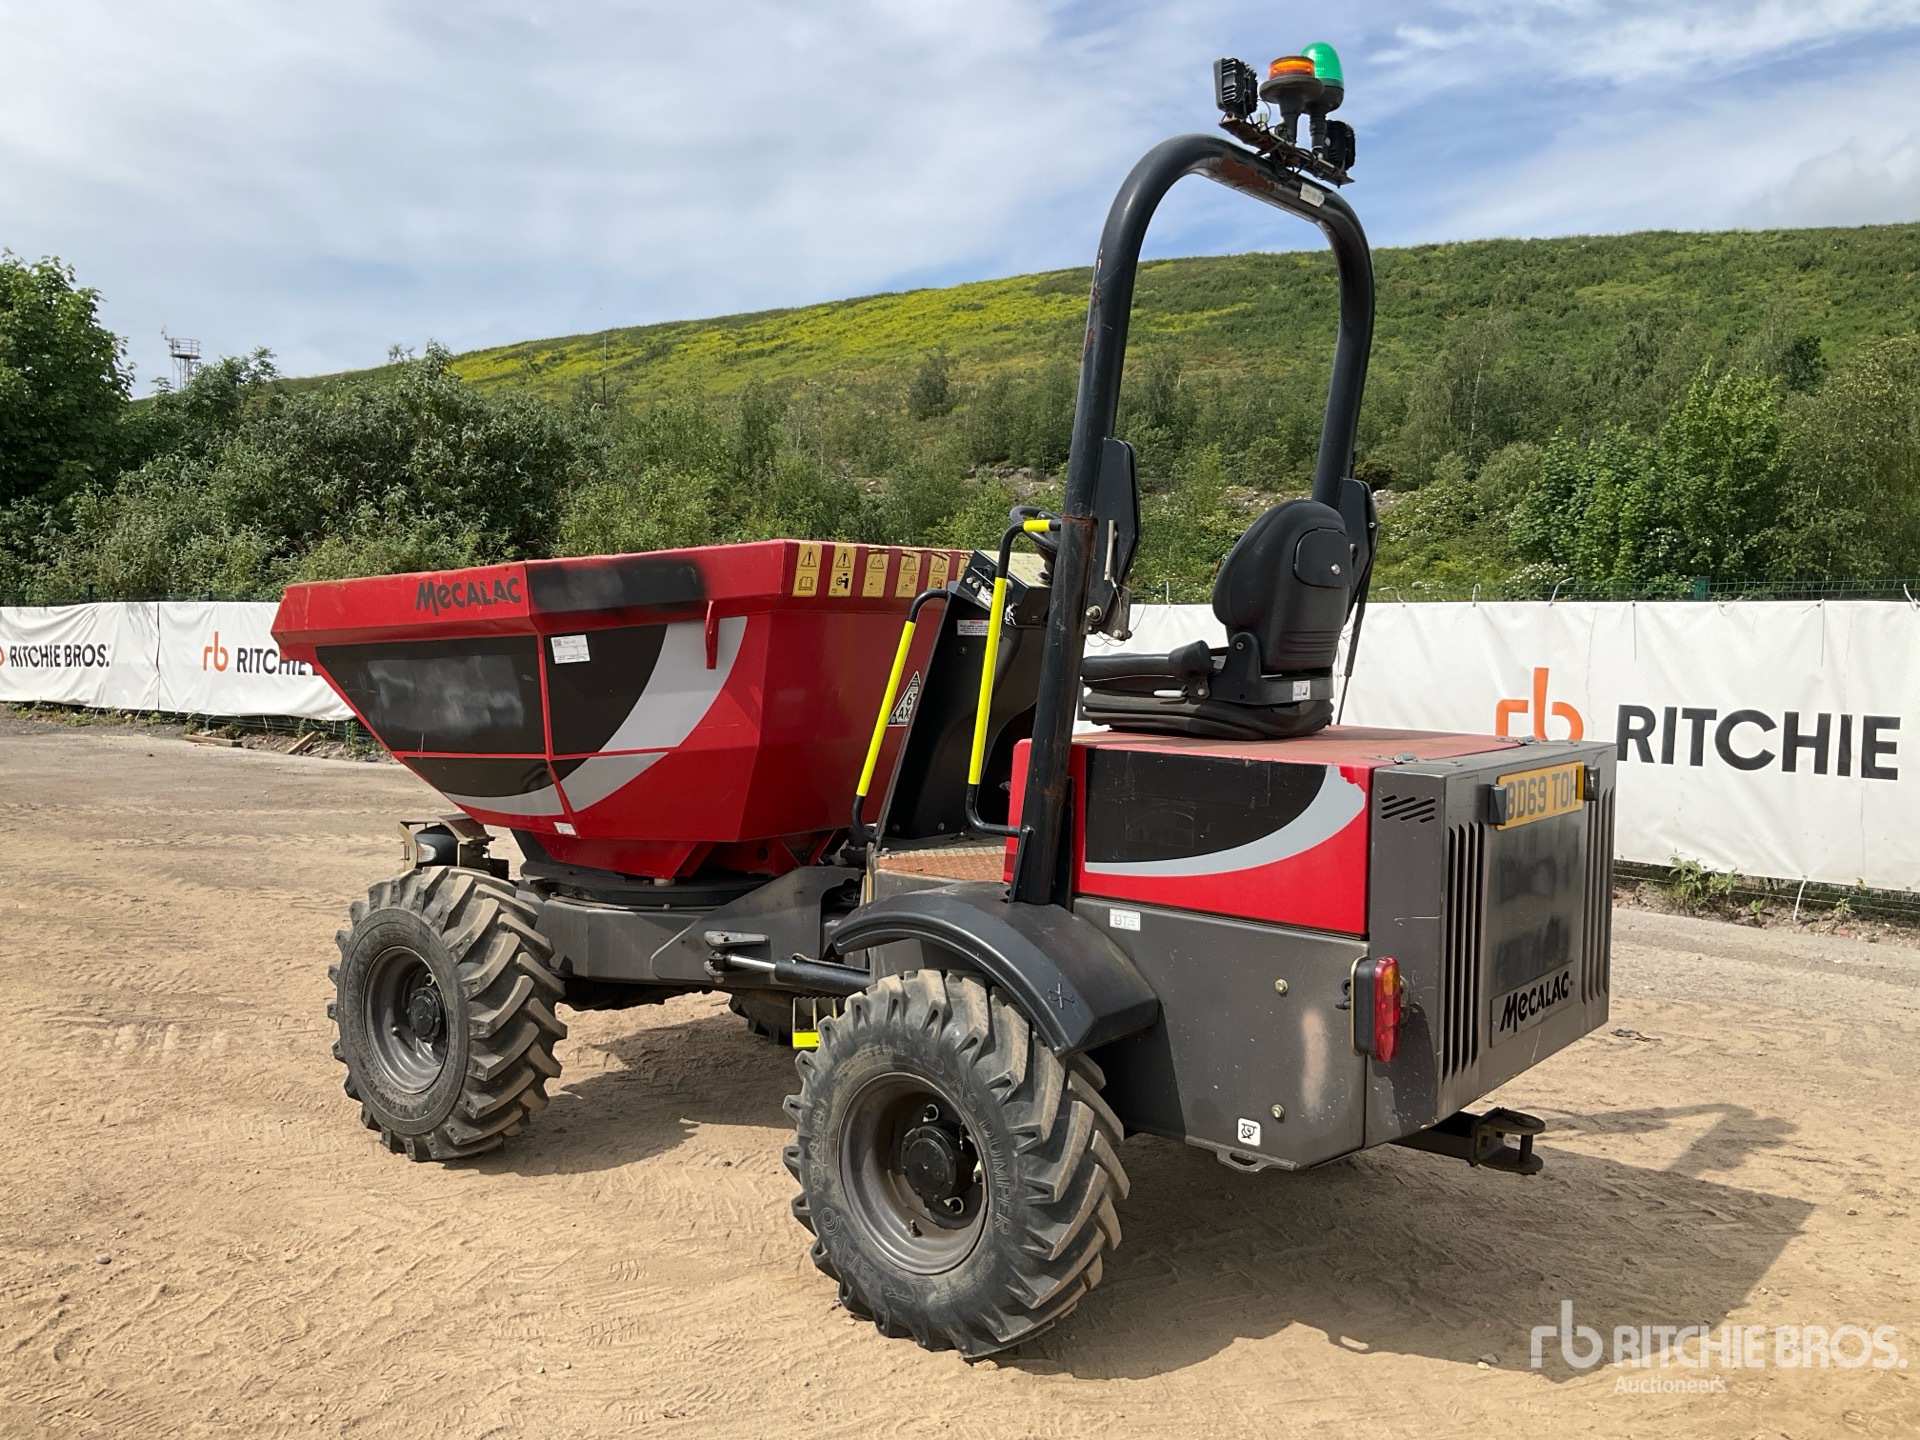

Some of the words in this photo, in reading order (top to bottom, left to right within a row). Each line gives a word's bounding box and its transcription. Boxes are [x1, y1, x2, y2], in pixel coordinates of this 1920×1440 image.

[9, 645, 61, 668] RITCHIE
[64, 644, 110, 668] BROS.
[203, 631, 229, 671] rb
[1617, 704, 1901, 780] RITCHIE
[1506, 775, 1548, 821] BD69
[979, 1117, 1013, 1236] DUMPER
